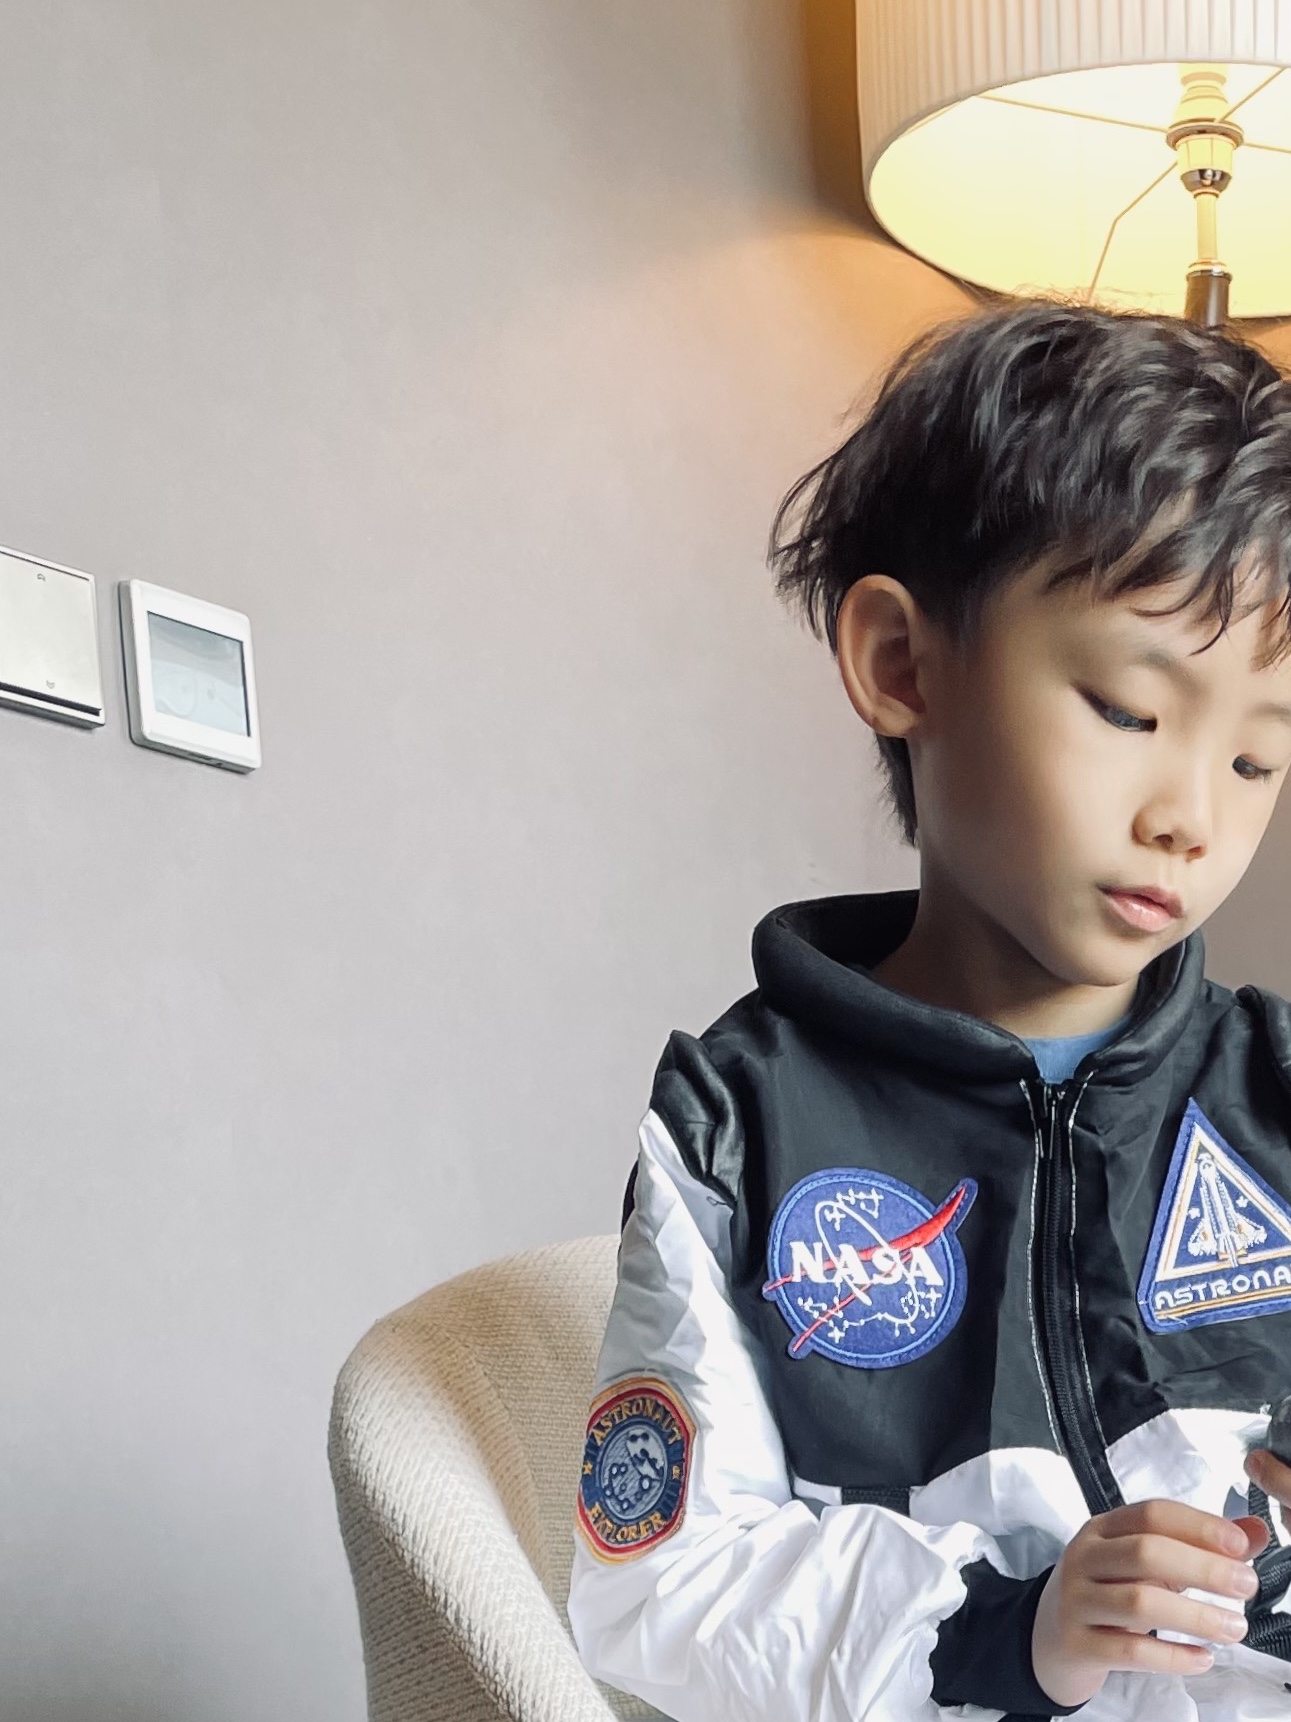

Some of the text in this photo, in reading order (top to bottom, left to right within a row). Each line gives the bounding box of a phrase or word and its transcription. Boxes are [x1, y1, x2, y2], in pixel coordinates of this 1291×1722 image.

[789, 1241, 944, 1286] NASA
[590, 1397, 682, 1446] ASTRONAUT
[587, 1501, 668, 1543] EXPLORER
